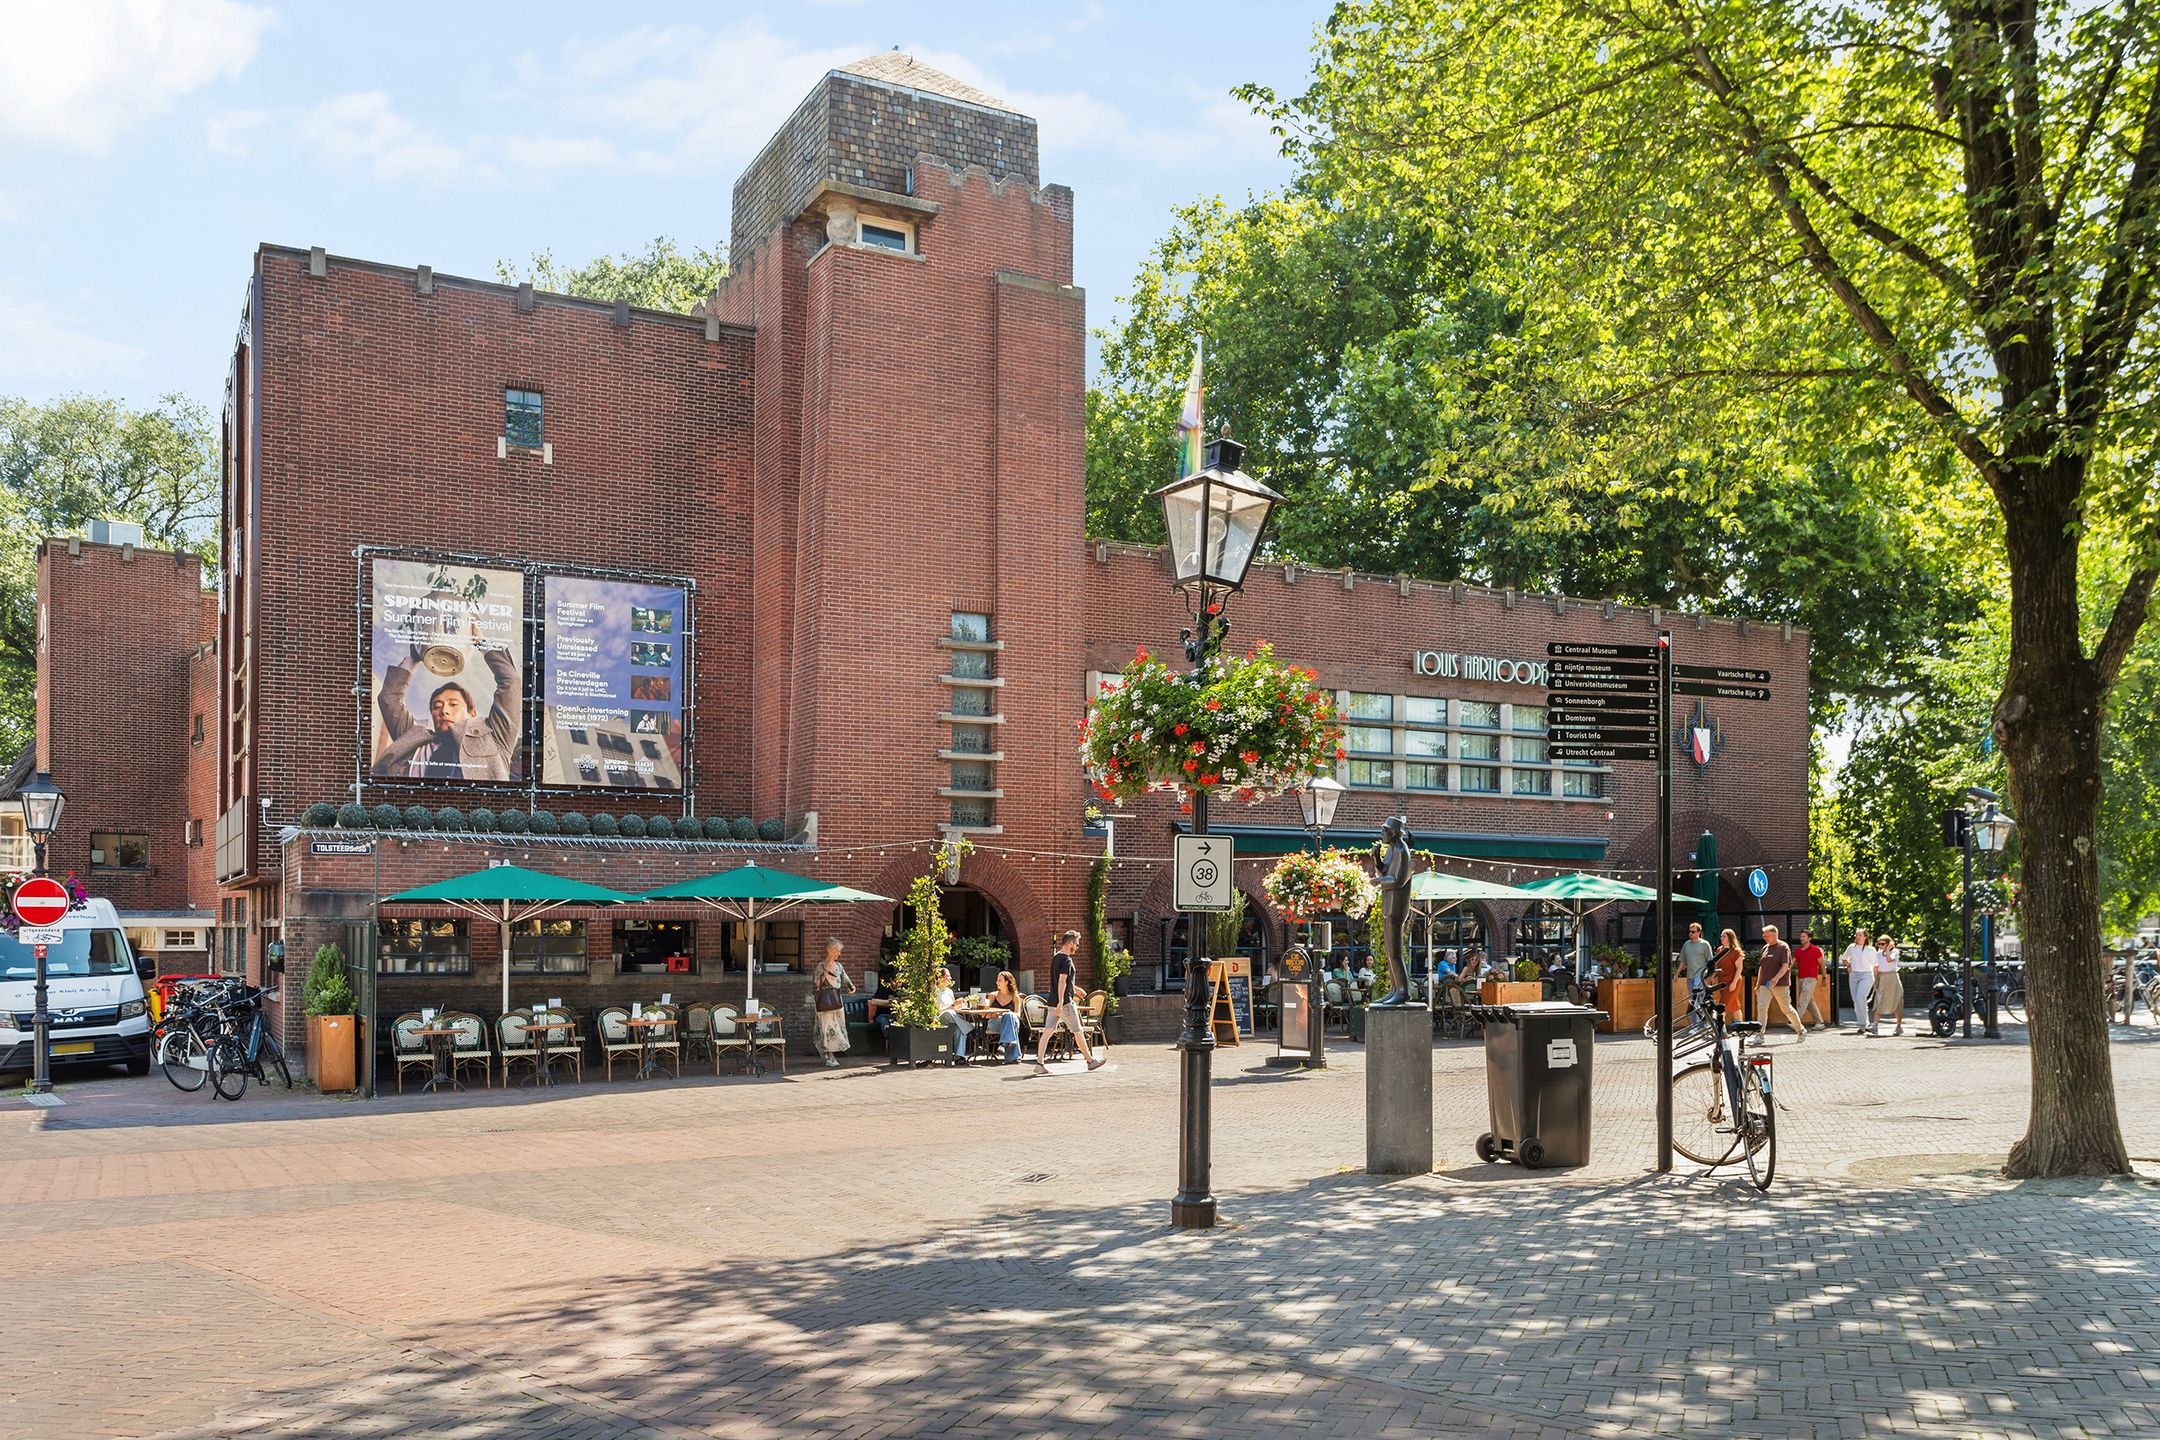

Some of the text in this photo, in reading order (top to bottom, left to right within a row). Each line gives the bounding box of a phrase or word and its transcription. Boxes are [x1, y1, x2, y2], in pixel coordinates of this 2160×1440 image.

[383, 594, 513, 617] SPRINGHAVER
[557, 600, 605, 611] Summer Film
[557, 608, 586, 617] Festival
[383, 610, 512, 631] Summer Film Festival
[557, 635, 595, 645] Previously
[557, 643, 598, 652] Unreleased
[1565, 646, 1591, 654] Centraal
[1415, 650, 1548, 687] LOUIS HARTLOOPE
[1565, 664, 1585, 672] nijntje
[557, 669, 600, 679] De Cineville
[1717, 670, 1756, 680] Vaartsche Rijn
[557, 677, 608, 688] Previewdagen
[1565, 680, 1628, 689] Universiteitsmuseum
[1717, 688, 1756, 698] Vaartsche Rijn
[1565, 697, 1605, 707] Sonnenborgh
[556, 704, 629, 717] Openluchtvertoning
[556, 712, 609, 722] Cabaret (1972)
[1565, 714, 1596, 722] Domtoren
[1565, 748, 1588, 756] Utrecht
[1196, 868, 1213, 881] 38
[53, 1016, 84, 1024] MAN
